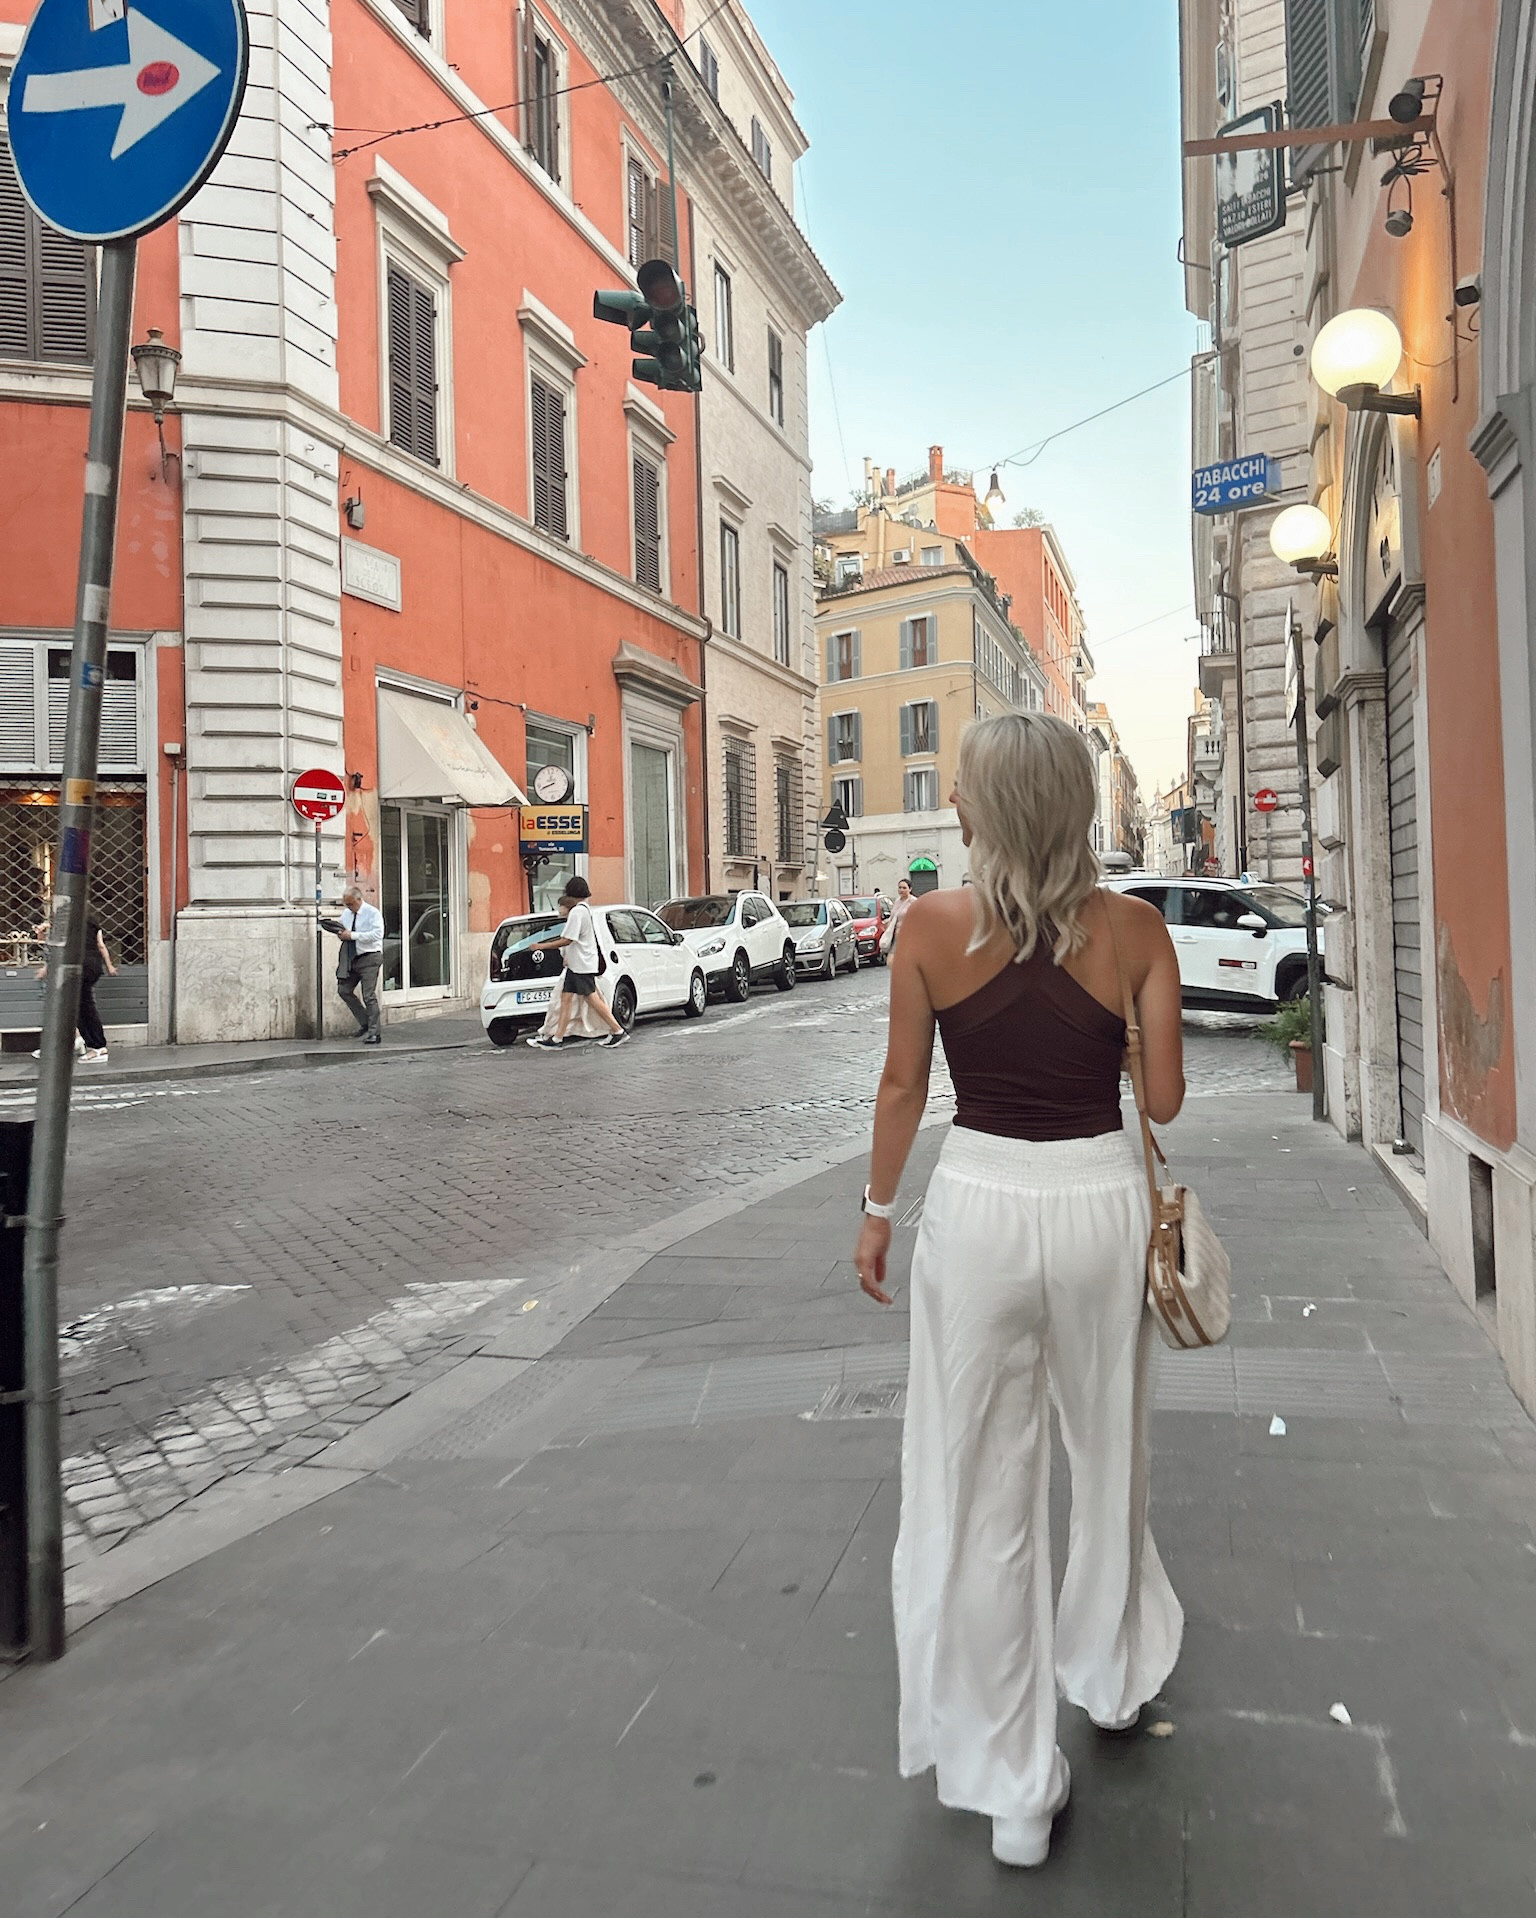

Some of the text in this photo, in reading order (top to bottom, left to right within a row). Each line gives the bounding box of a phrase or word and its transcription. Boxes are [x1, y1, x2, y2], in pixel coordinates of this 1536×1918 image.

[1195, 458, 1265, 489] TABACCHI
[1195, 481, 1265, 507] 24 ore
